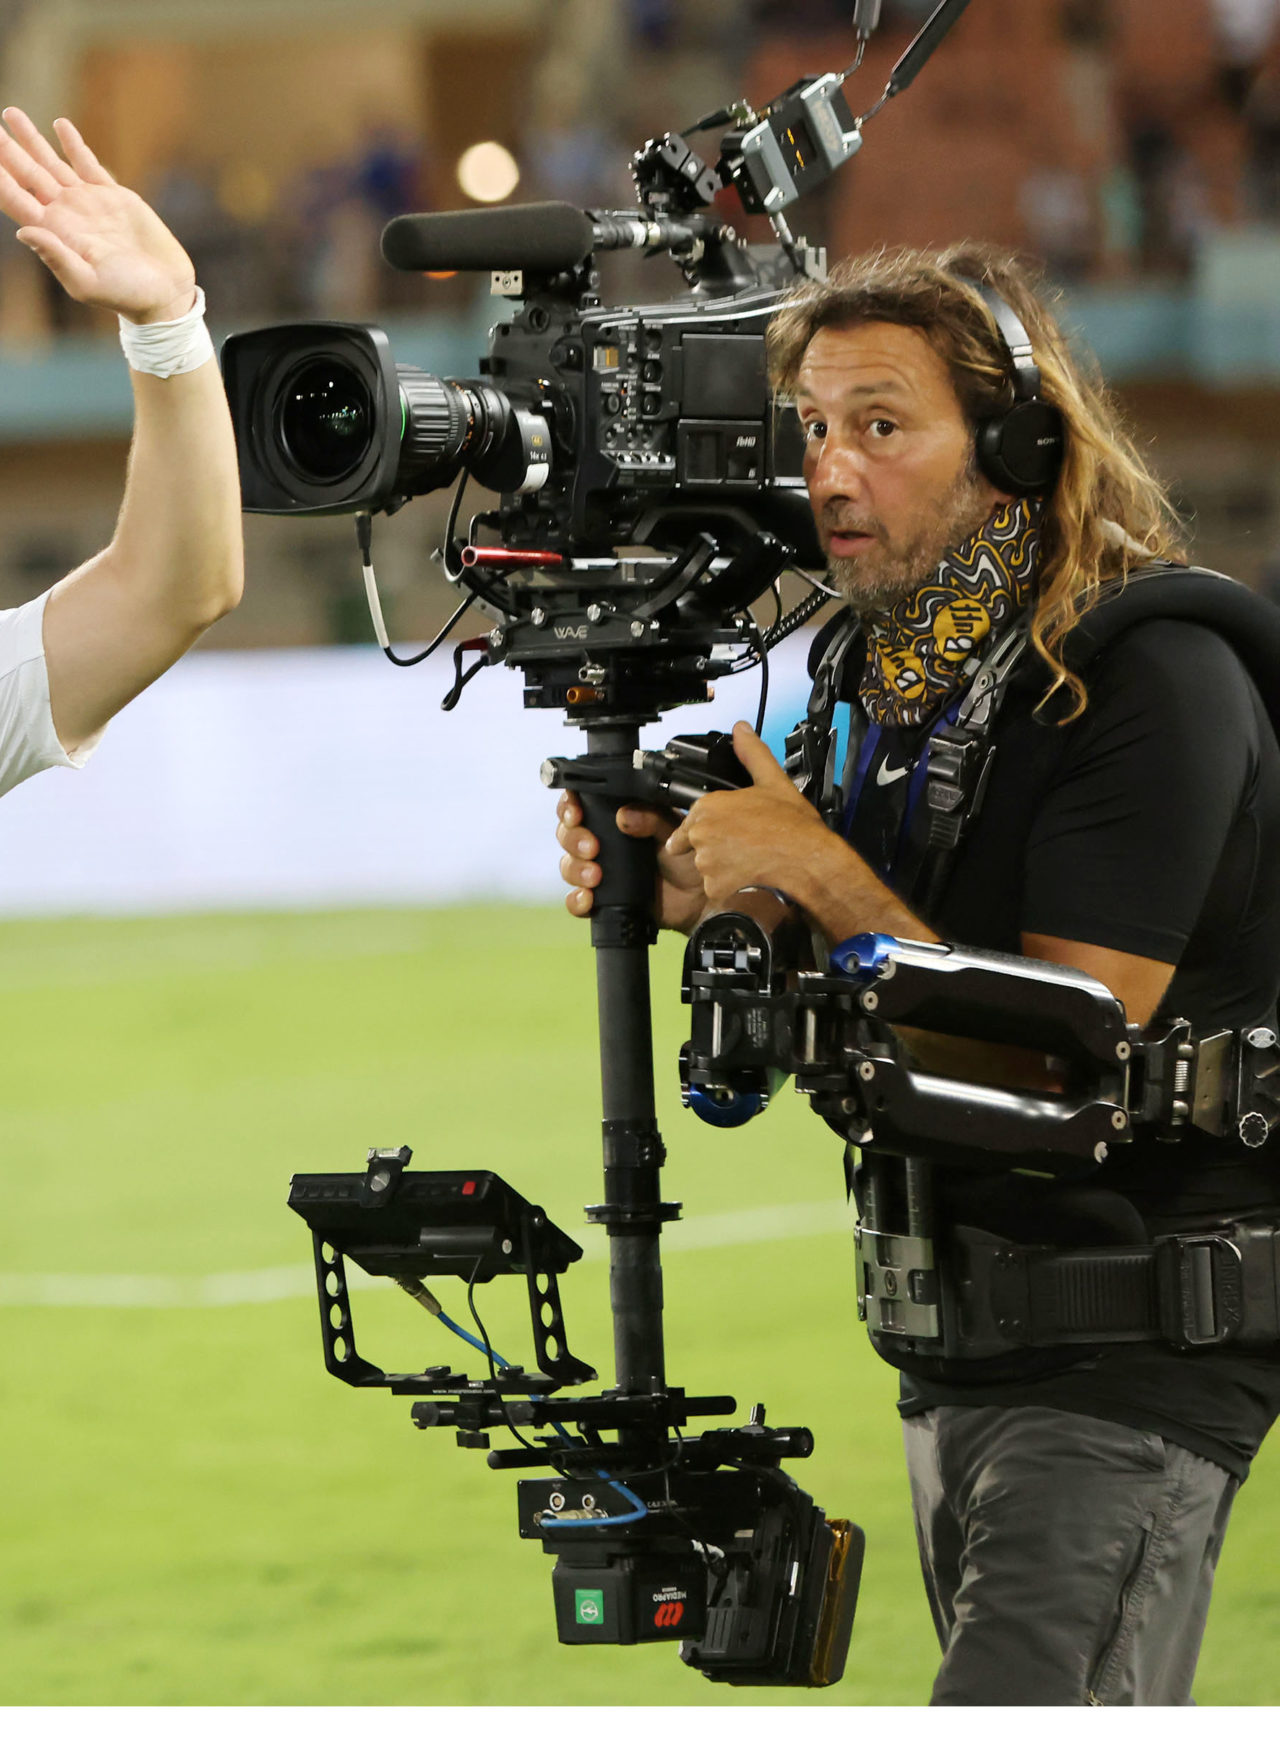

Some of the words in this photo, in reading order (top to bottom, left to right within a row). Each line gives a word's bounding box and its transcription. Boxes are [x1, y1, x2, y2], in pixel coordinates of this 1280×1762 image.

[553, 624, 589, 640] WAVE
[942, 603, 983, 654] Buff
[652, 1590, 687, 1603] MEDIAPRO
